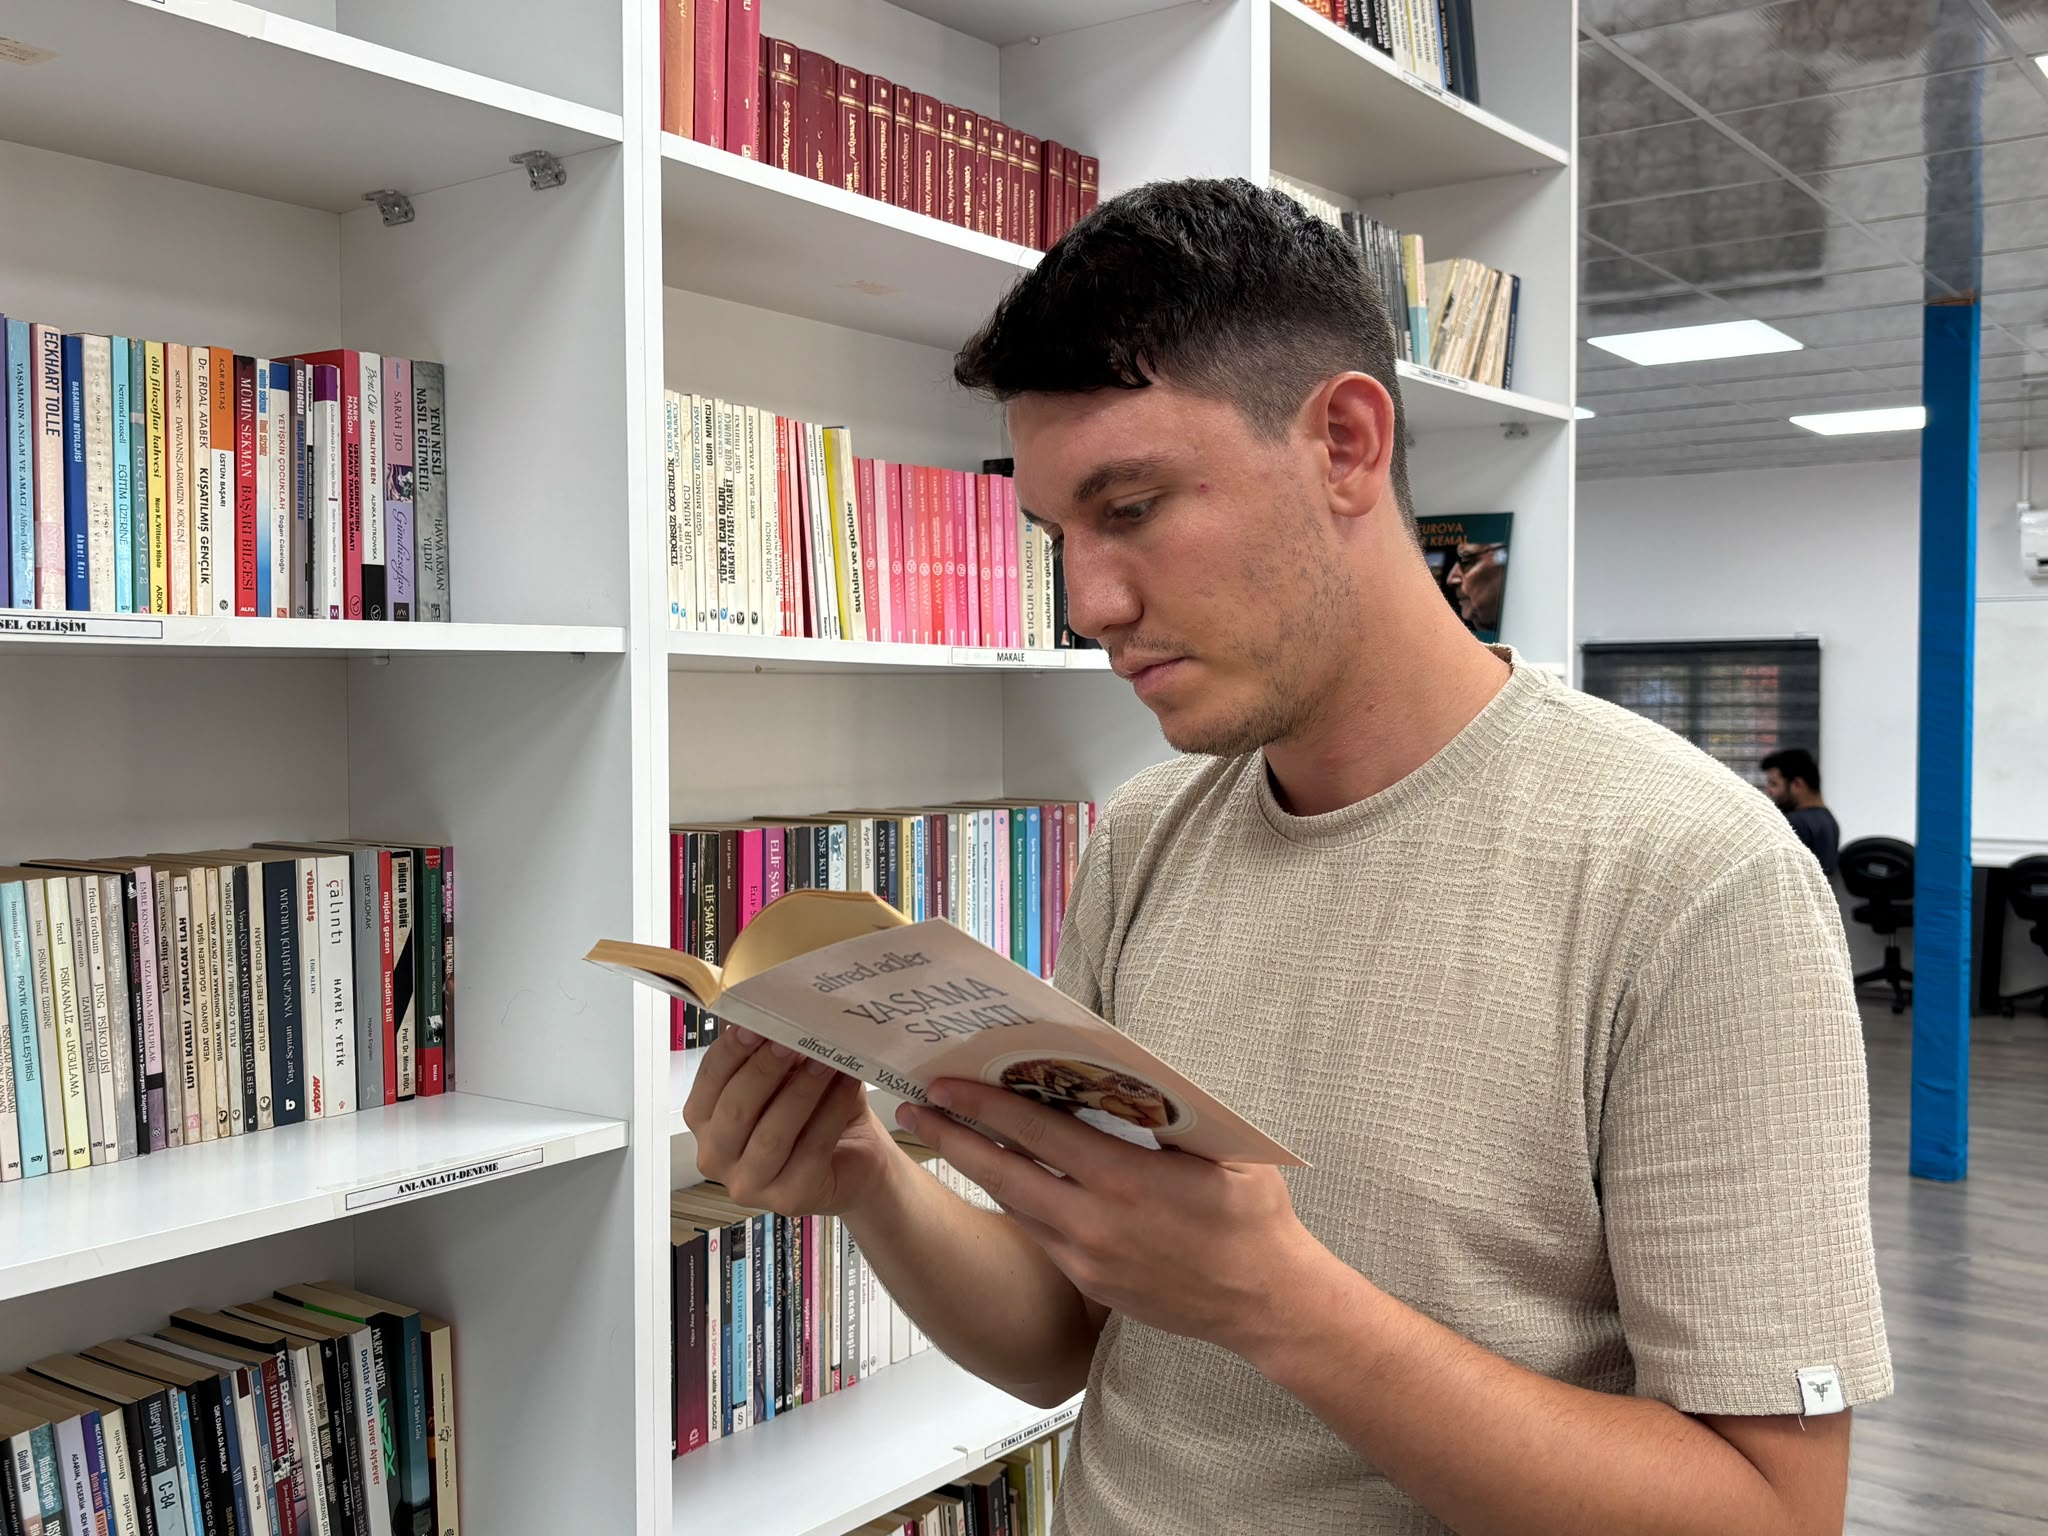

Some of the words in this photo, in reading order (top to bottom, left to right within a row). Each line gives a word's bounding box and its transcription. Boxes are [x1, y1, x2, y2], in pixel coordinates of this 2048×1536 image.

[44, 331, 60, 393] ECKHART
[152, 356, 160, 374] ölü
[198, 358, 207, 371] Dr.
[16, 363, 25, 419] YAŞAMANIN
[150, 376, 161, 432] filozoflar
[198, 375, 208, 407] ERDAL
[240, 377, 252, 422] MÜMİN
[416, 388, 427, 424] NASIL
[45, 396, 61, 437] TOLLE
[393, 391, 402, 430] SARAH
[431, 407, 443, 436] YENİ
[18, 420, 26, 456] ANLAM
[199, 411, 208, 448] ATABEK
[278, 413, 286, 455] YETİŞKİN
[394, 432, 403, 451] JIO
[153, 435, 161, 478] kahvesi
[241, 424, 252, 477] SEKMAN
[432, 441, 444, 476] NESLİ
[19, 476, 27, 507] AMACI
[197, 467, 209, 532] KUŞATILMIŞ
[667, 458, 677, 512] ÖZGÜRLÜK
[240, 485, 253, 535] BAŞARI
[683, 485, 692, 527] MUMCU
[434, 519, 443, 553] HAVVA
[668, 515, 678, 567] TERÖRSÜZ
[718, 517, 727, 543] İCAD
[198, 536, 211, 584] GENÇLİK
[242, 539, 254, 591] BİLGESİ
[424, 537, 433, 571] YILDIZ
[718, 546, 728, 583] TÜFEK
[852, 551, 858, 565] ve
[1026, 541, 1034, 589] MUMCU
[436, 554, 445, 591] AKMAN
[26, 619, 87, 633] GELİŞİM
[997, 652, 1025, 662] MAKALE
[770, 839, 782, 869] ELİF
[818, 827, 828, 855] AYŞE
[878, 827, 887, 852] AYŞE
[398, 862, 408, 893] DÜNDEN
[878, 857, 887, 887] KULİN
[88, 887, 97, 914] frieda
[140, 881, 148, 910] EMRE
[224, 882, 232, 916] DÜŞMEK
[382, 891, 390, 924] müjdat
[705, 884, 715, 902] ELİF
[142, 911, 152, 946] KONGAR
[326, 880, 344, 945] Çalıntı
[703, 903, 715, 937] ŞAFAK
[90, 915, 99, 954] fordham
[178, 917, 187, 943] İLAH
[161, 936, 169, 960] Hugo
[254, 927, 262, 970] ERDURAN
[144, 960, 154, 1007] KIZLARIMA
[180, 946, 191, 1006] TAPILACAK
[198, 948, 207, 992] GÖLGEDEN
[812, 962, 877, 994] alfred
[872, 951, 933, 977] adler
[17, 975, 28, 1007] PRATİK
[60, 967, 75, 1025] PSİKANALİZ
[94, 983, 106, 1009] JUNG
[256, 975, 264, 1001] REFİK
[334, 979, 345, 1013] HAYRİ
[384, 971, 392, 1007] haddini
[842, 977, 1009, 1026] YAŞAMA
[21, 1009, 29, 1034] USUN
[66, 1028, 73, 1037] ve
[146, 1008, 156, 1062] MEKTUPLAR
[200, 1002, 208, 1034] GÜNYOL
[335, 1018, 343, 1030] K.
[905, 1003, 1035, 1043] SANATI
[97, 1015, 111, 1074] PSİKOLOJİSİ
[184, 1020, 193, 1057] KALELİ
[285, 1026, 295, 1060] Seyman
[335, 1034, 344, 1067] YETİK
[798, 1035, 836, 1059] alfred
[832, 1052, 864, 1072] adler
[22, 1035, 35, 1081] ELEŞTİRİSİ
[67, 1039, 80, 1098] UYGULAMA
[85, 1041, 96, 1073] TEORİSİ
[286, 1061, 295, 1085] Yaşar
[185, 1061, 195, 1089] LÜTFİ
[312, 1075, 321, 1113] AKAŞA
[397, 1162, 499, 1195] ANI-ANLATI-DENEME
[848, 1268, 857, 1286] ölü
[849, 1290, 857, 1321] erkek
[847, 1326, 858, 1360] kuşlar
[275, 1350, 287, 1380] Kar
[361, 1349, 370, 1385] Dostlar
[270, 1384, 280, 1408] SEVİM
[343, 1382, 353, 1414] Dündar
[364, 1387, 375, 1417] Kitabı
[149, 1401, 164, 1440] Hüseyin
[273, 1410, 285, 1454] KAHRAMAN
[367, 1418, 377, 1446] Enver
[1054, 1410, 1073, 1423] ROMAN
[114, 1430, 122, 1454] Nesin
[153, 1439, 167, 1468] Edemir
[17, 1449, 28, 1473] Gönül
[118, 1454, 126, 1480] Ahmet
[369, 1449, 380, 1485] Aysever
[159, 1480, 175, 1510] C-84
[80, 1512, 88, 1526] BEN
